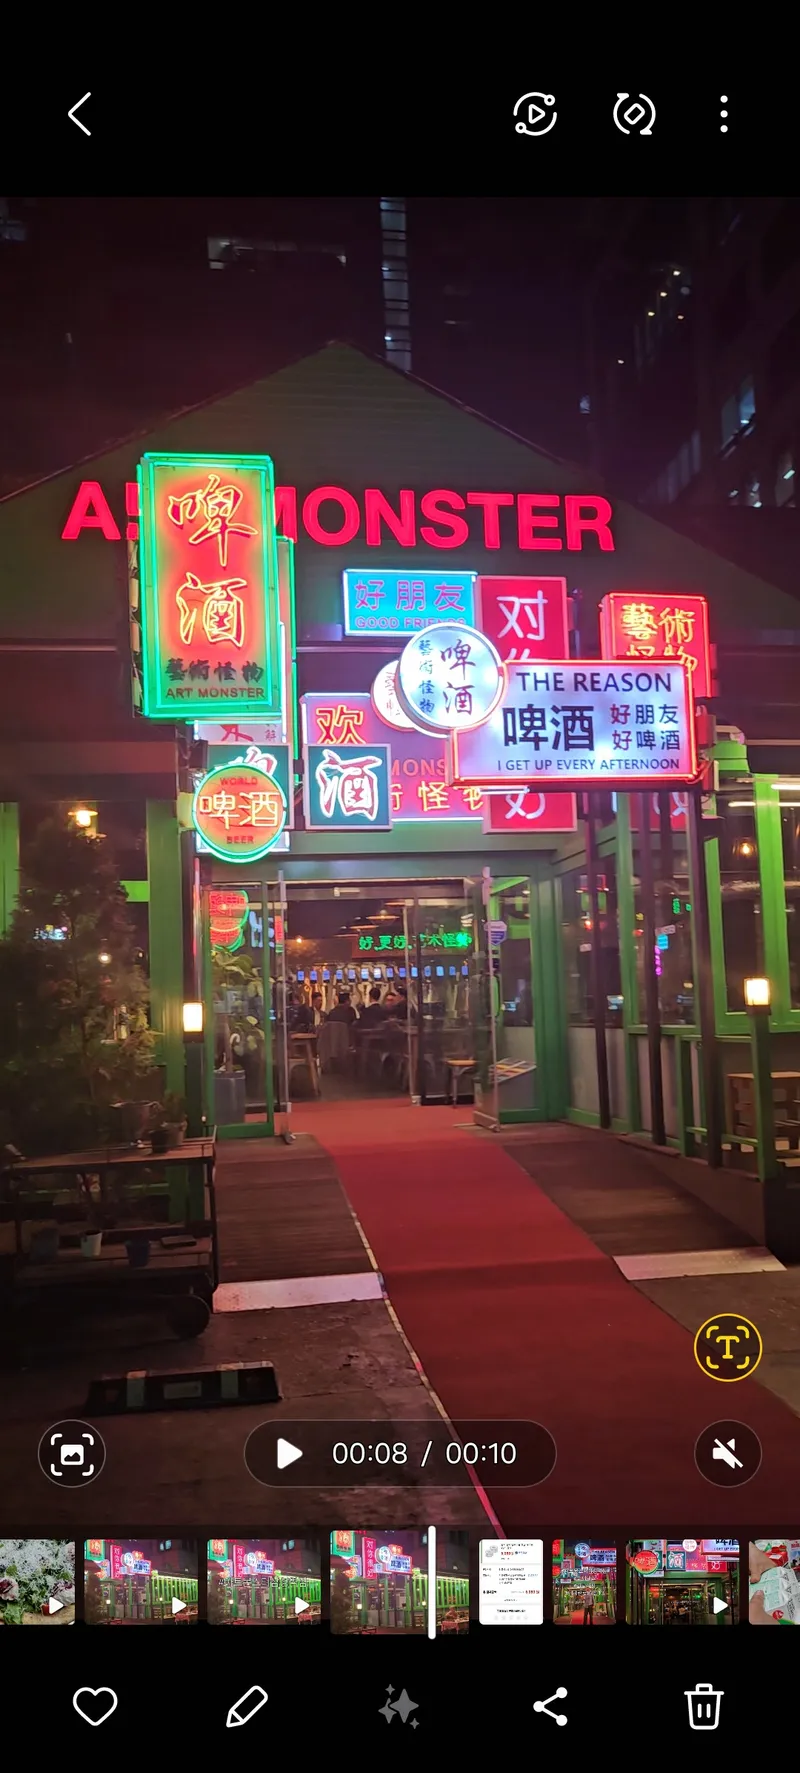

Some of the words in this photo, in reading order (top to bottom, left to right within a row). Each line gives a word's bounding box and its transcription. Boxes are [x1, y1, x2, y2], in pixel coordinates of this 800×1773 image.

[168, 474, 259, 648] 啤酒
[355, 579, 465, 611] 好朋友
[355, 617, 399, 629] GOOD
[440, 639, 477, 715] 啤酒
[516, 672, 564, 692] THE
[574, 671, 672, 692] REASON
[165, 687, 194, 699] ART
[198, 686, 266, 699] MONSTER
[610, 703, 679, 725] 好朋友
[502, 703, 595, 751] 啤酒
[611, 729, 681, 751] 好啤酒
[505, 759, 530, 771] GET
[535, 759, 552, 770] UP
[557, 759, 595, 770] EVERY
[600, 758, 680, 770] AFTERNOON
[315, 748, 383, 822] 酒
[199, 791, 280, 830] 啤酒
[226, 835, 254, 844] BEER
